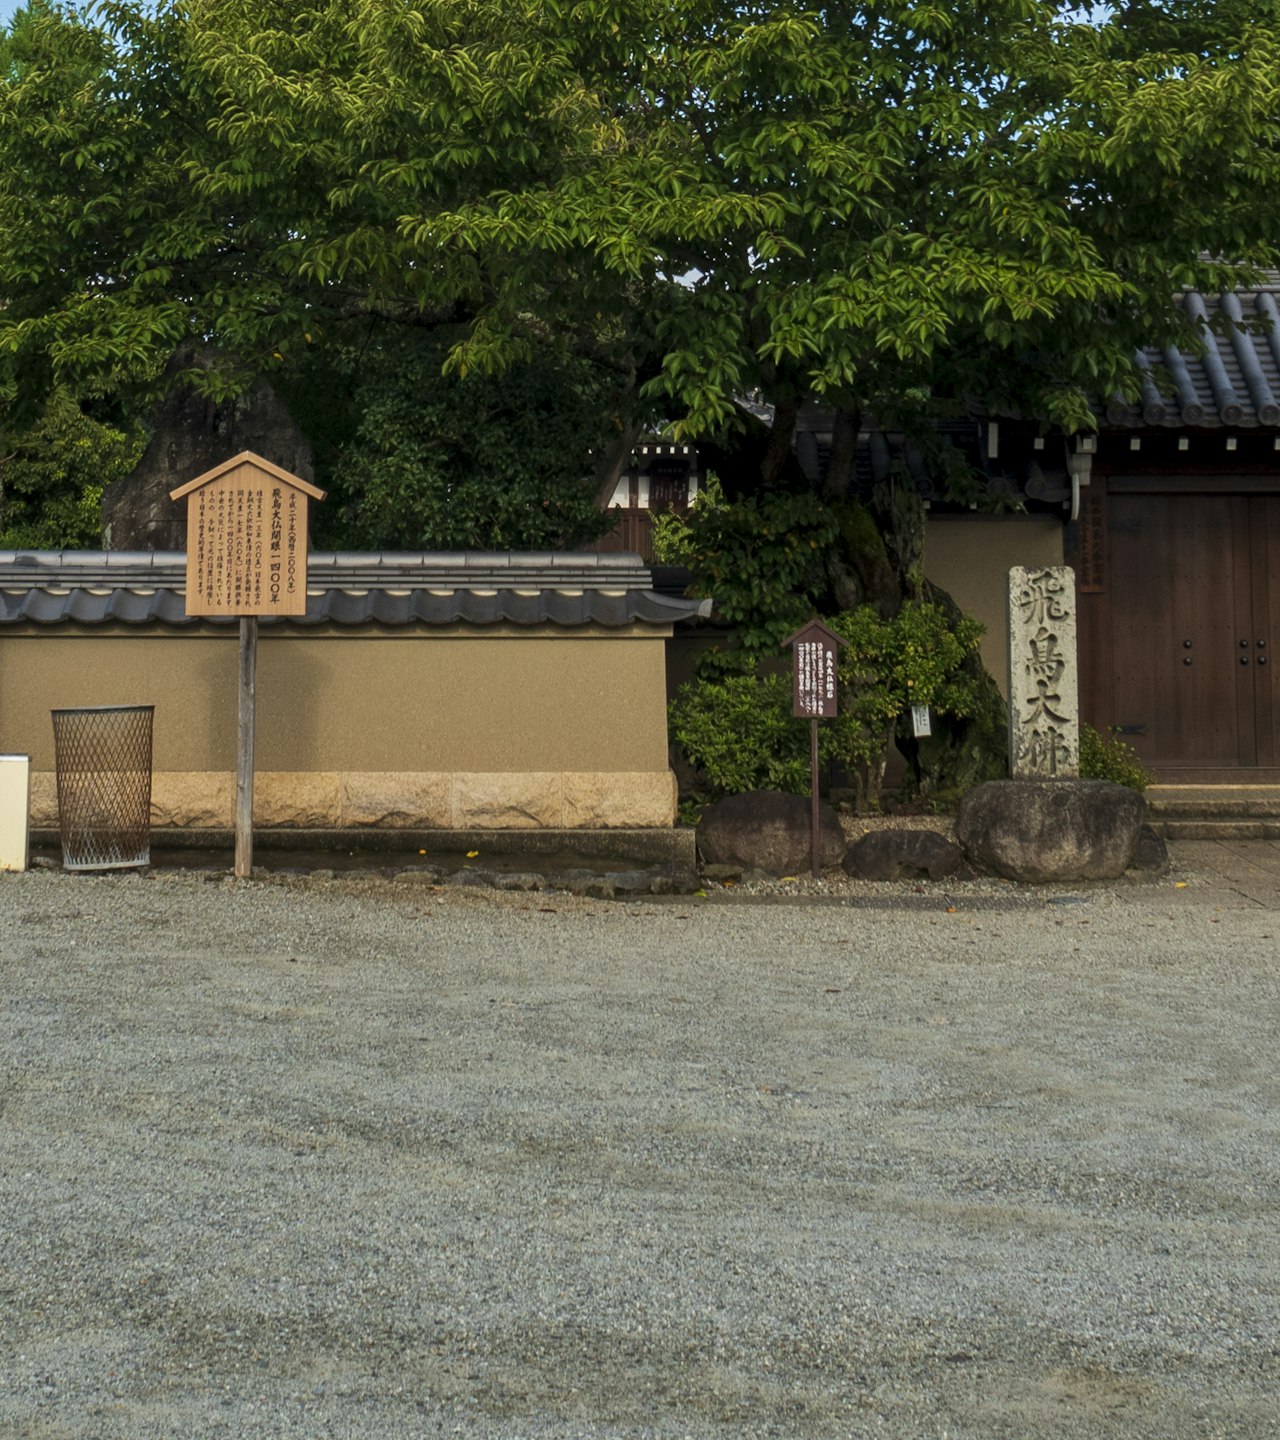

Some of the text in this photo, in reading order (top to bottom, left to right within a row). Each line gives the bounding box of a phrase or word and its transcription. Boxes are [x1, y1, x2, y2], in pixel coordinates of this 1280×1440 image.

[269, 487, 282, 604] 飛鳥大仏開眼一四〇〇年
